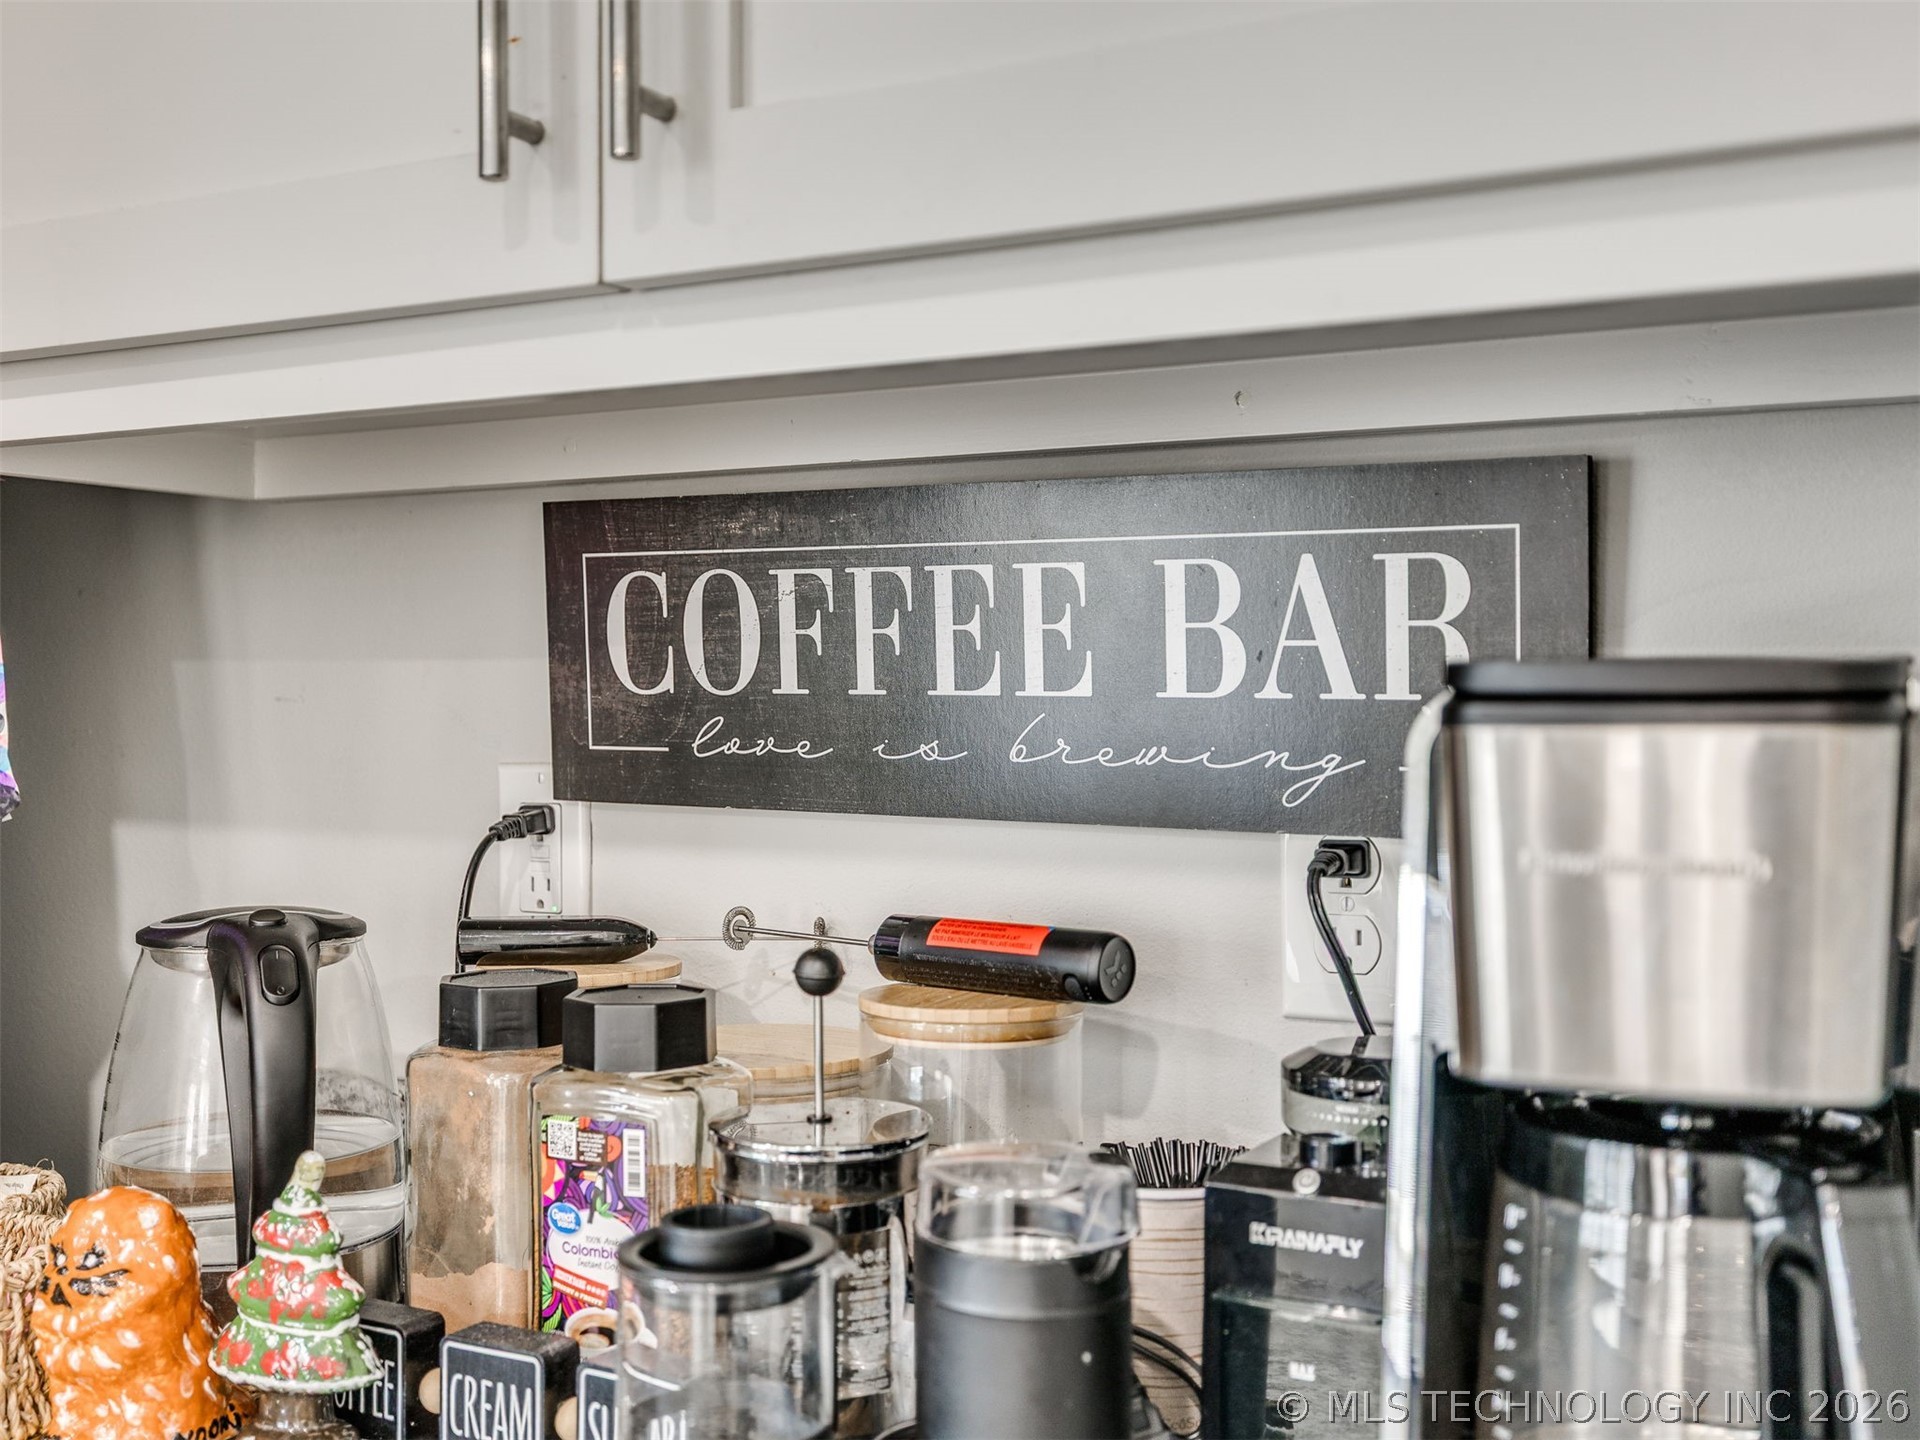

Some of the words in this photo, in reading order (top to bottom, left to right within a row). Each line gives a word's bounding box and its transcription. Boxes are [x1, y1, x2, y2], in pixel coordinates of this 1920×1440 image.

[606, 560, 1093, 697] COFFEE
[1152, 552, 1472, 700] BAR
[691, 715, 834, 758] love
[873, 738, 969, 761] is
[1009, 713, 1367, 808] brewing
[562, 1241, 619, 1259] Colombi
[449, 1373, 534, 1440] CREAM
